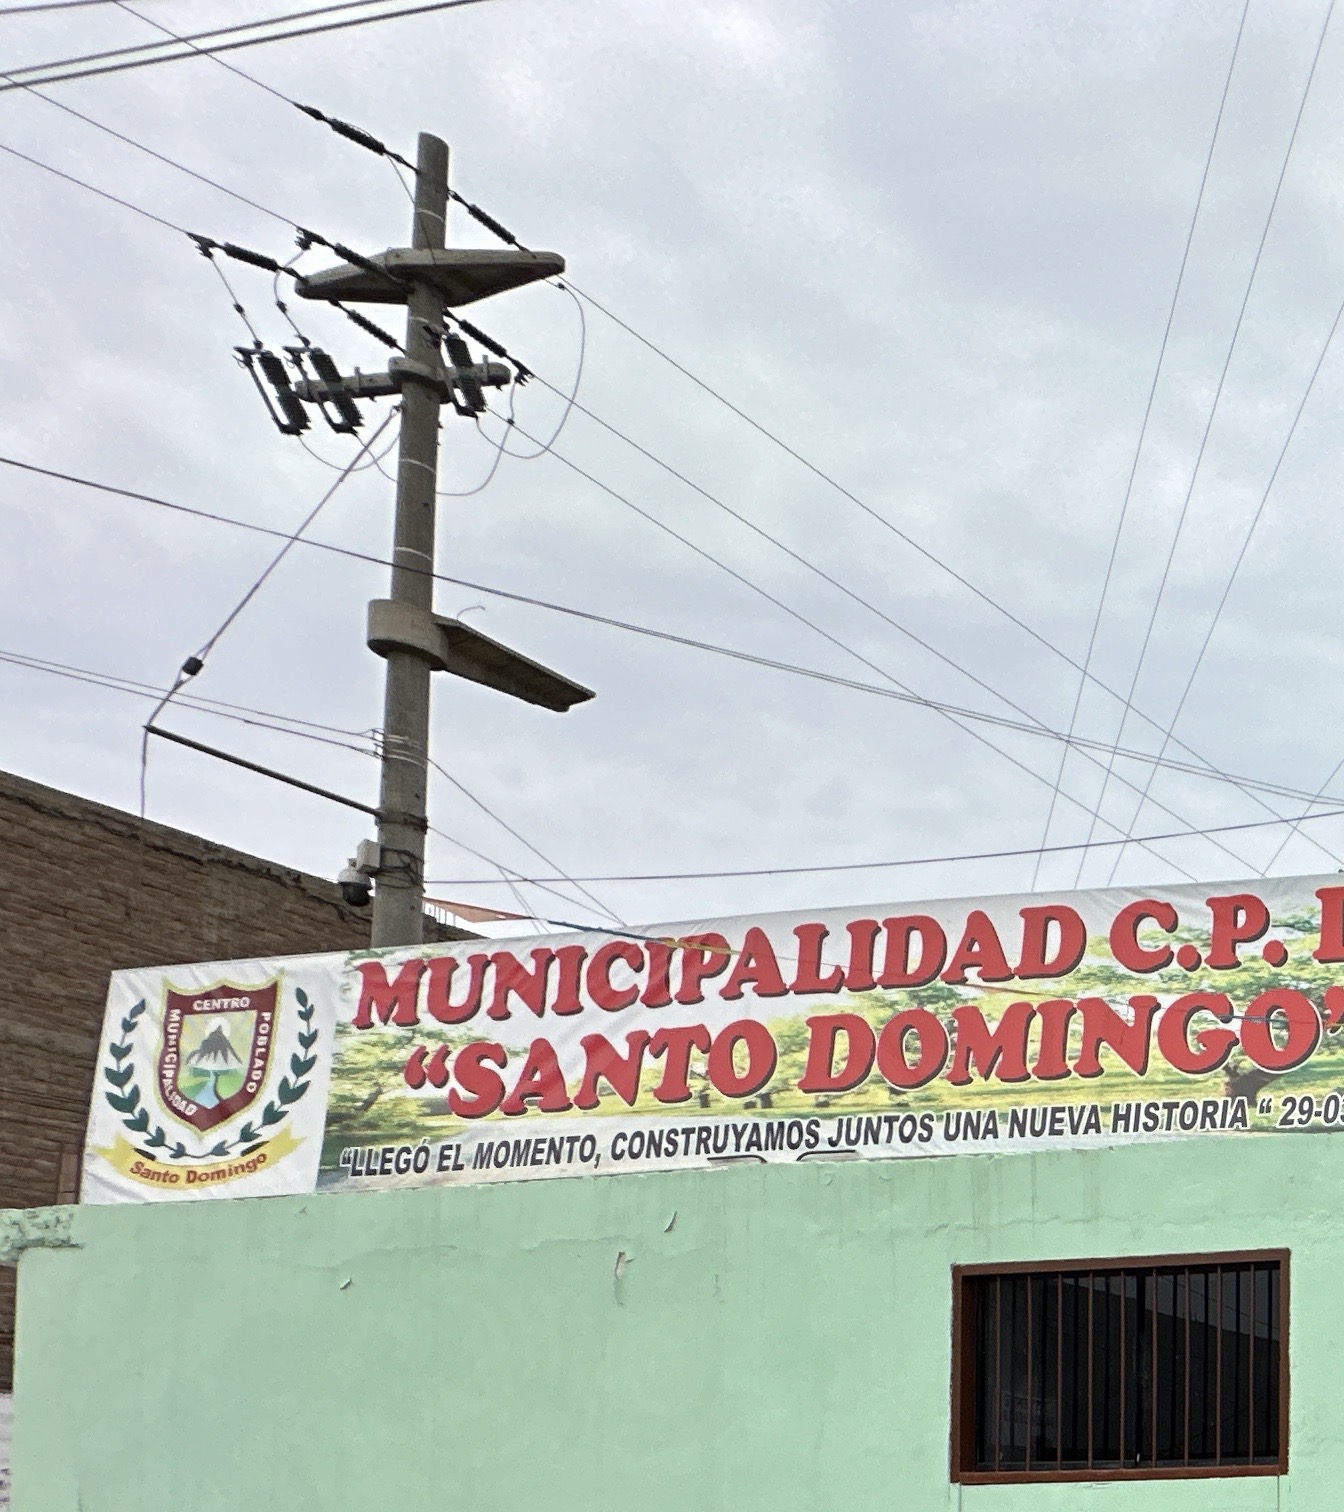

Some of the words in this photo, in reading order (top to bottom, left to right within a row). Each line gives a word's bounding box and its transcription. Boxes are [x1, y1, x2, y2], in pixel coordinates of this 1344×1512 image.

[354, 904, 1087, 1029] MUNICIPALIDAD
[1109, 893, 1289, 973] C.P.
[192, 996, 251, 1011] CENTRO
[246, 1011, 272, 1094] POBLADO
[404, 1018, 777, 1119] “SANTO
[130, 1160, 181, 1184] Santo
[185, 1152, 267, 1184] Domingo
[436, 1144, 465, 1172] EL
[472, 1133, 601, 1169] MOMENTO,
[610, 1118, 820, 1161] CONSTRUYAMOS
[827, 1112, 933, 1147] JUNTOS
[944, 1109, 999, 1141] UNA
[1008, 1105, 1101, 1138] NUEVA
[1111, 1099, 1249, 1133] HISTORIA
